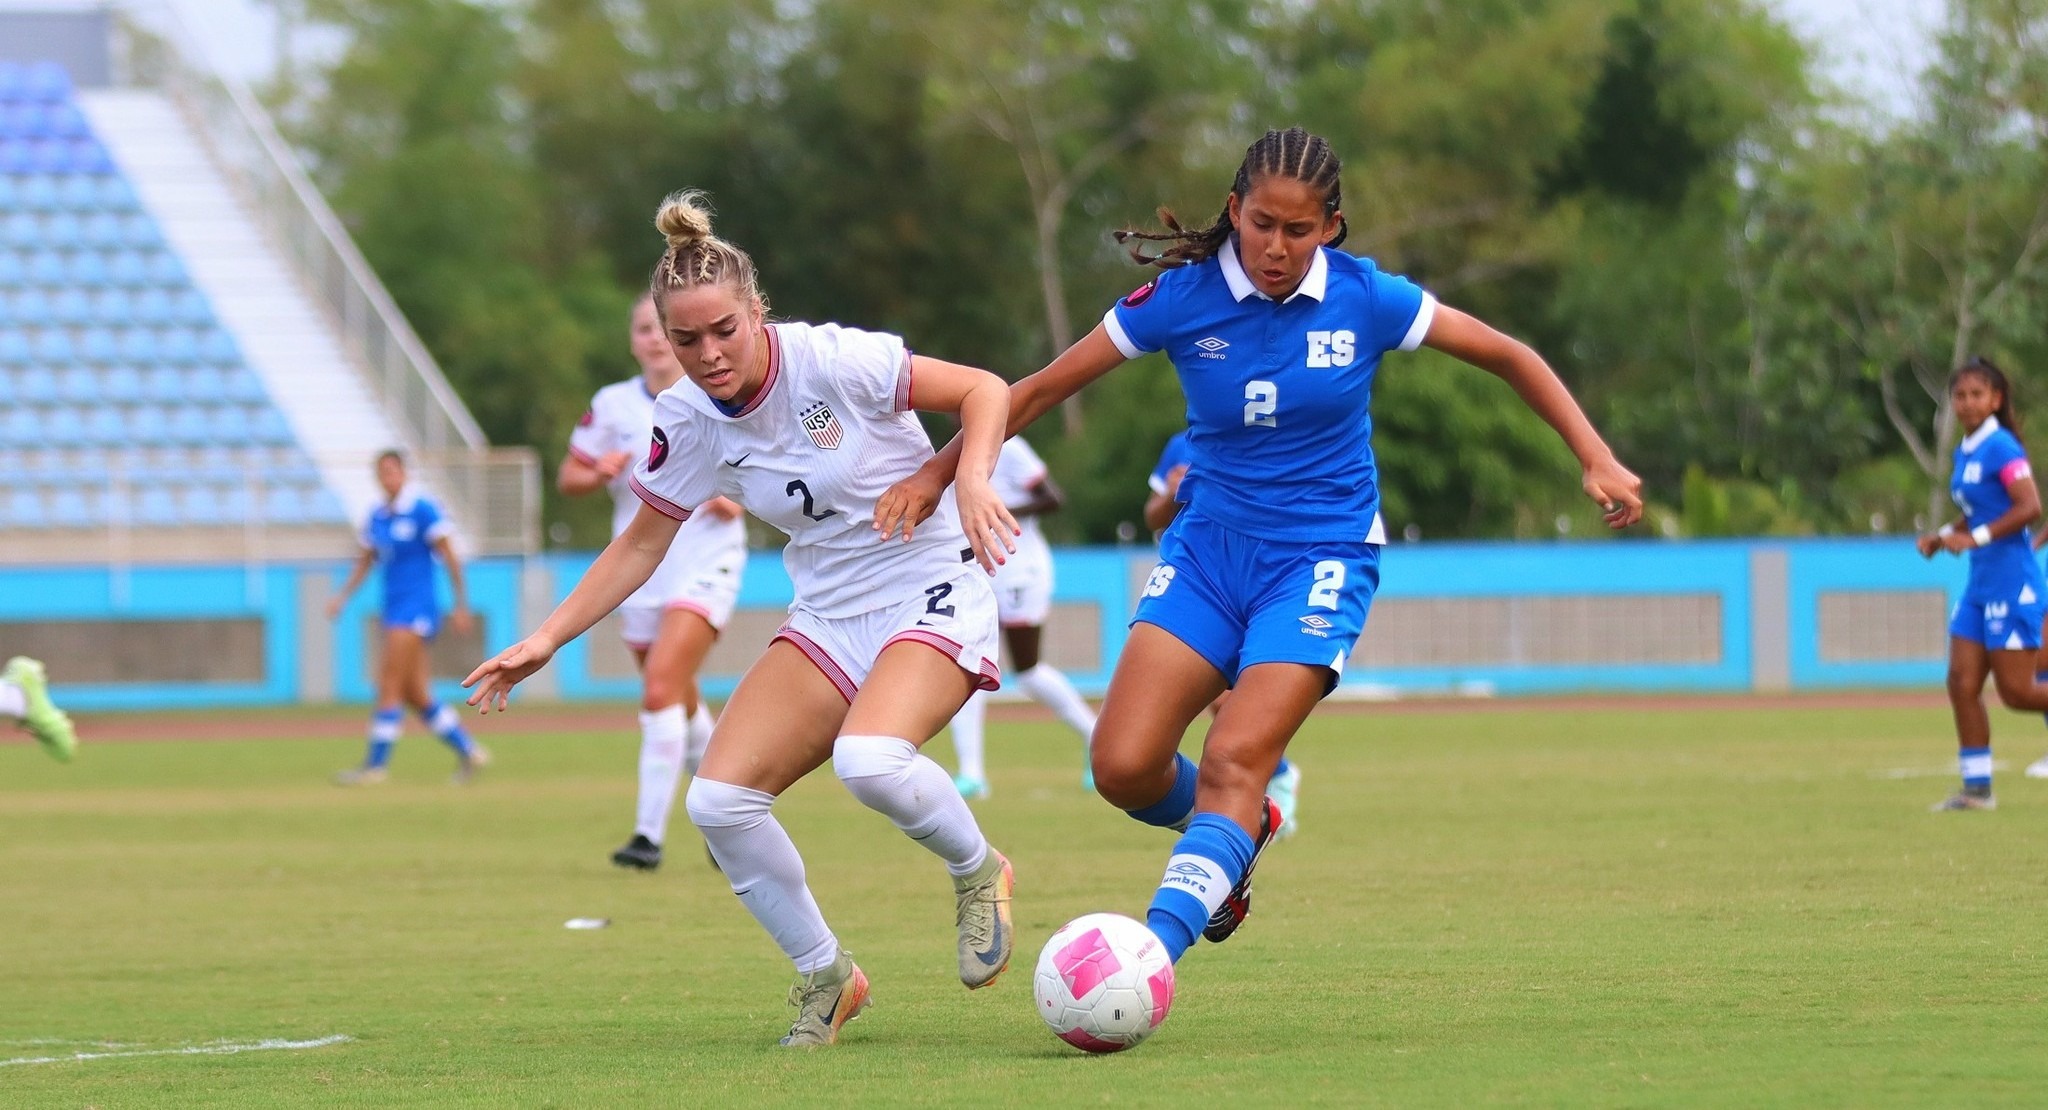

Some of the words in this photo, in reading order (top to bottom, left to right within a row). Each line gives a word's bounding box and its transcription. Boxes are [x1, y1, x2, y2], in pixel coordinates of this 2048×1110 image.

[1198, 351, 1226, 360] umbro
[1306, 330, 1355, 368] ES
[806, 409, 831, 430] USA
[1244, 380, 1277, 427] 2
[786, 480, 837, 521] 2
[925, 582, 955, 618] 2
[1307, 560, 1346, 611] 2
[1301, 626, 1328, 638] umbro
